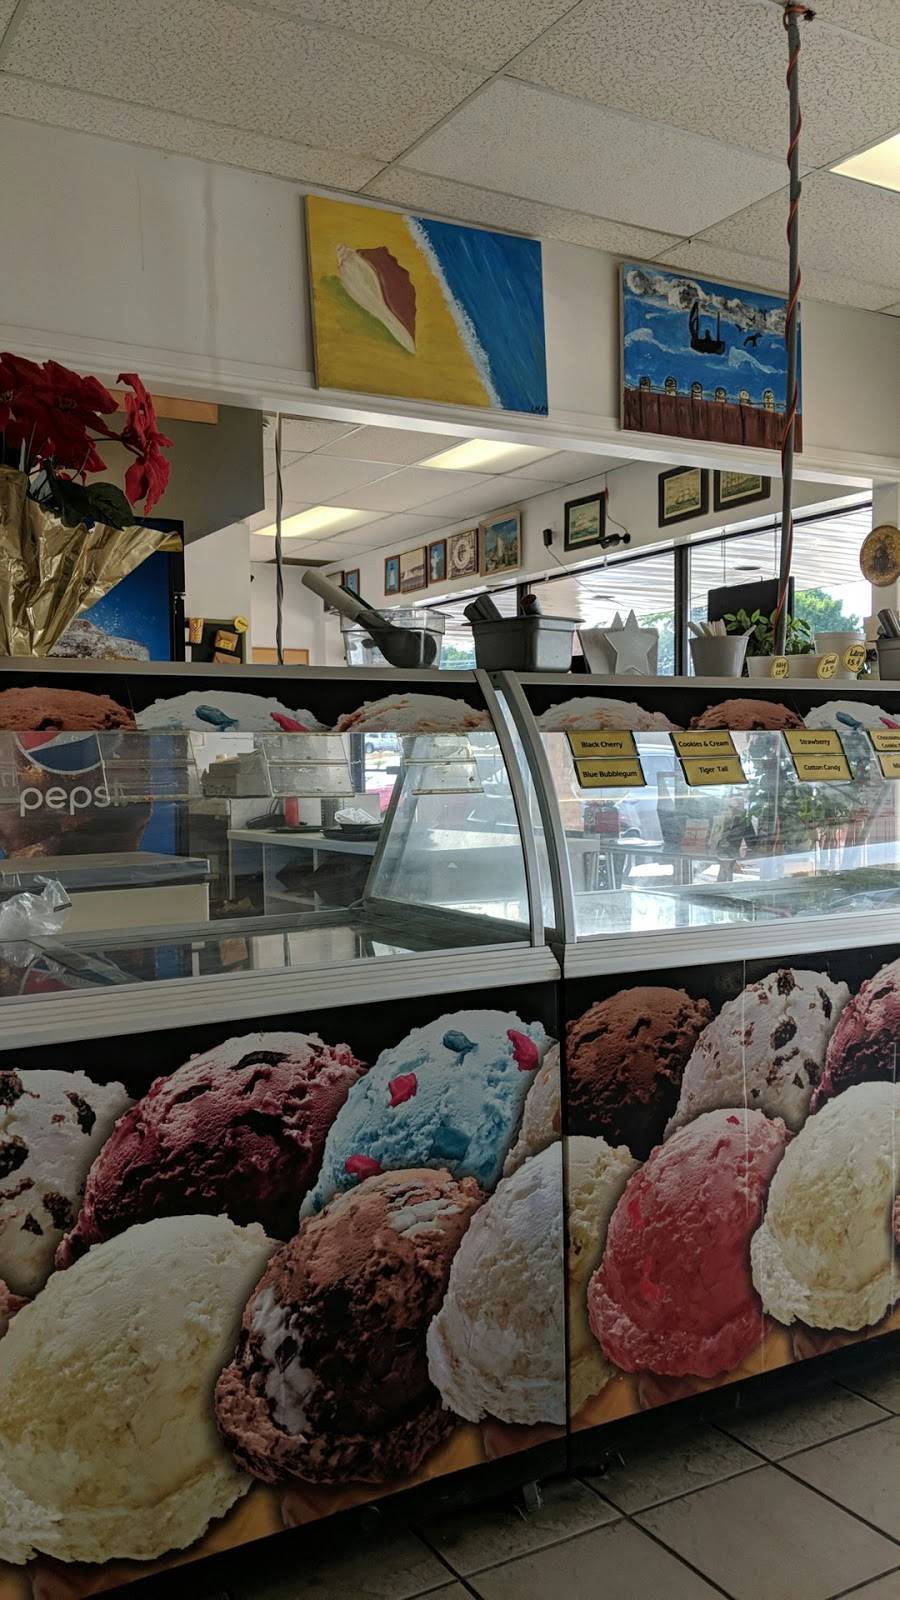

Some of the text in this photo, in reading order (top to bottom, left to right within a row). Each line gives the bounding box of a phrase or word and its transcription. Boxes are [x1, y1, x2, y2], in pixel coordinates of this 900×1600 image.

[600, 741, 623, 749] Cherry
[799, 738, 831, 746] Strawberry
[699, 767, 715, 775] Tiger
[823, 764, 841, 772] Candy
[599, 770, 638, 778] Bubblegum
